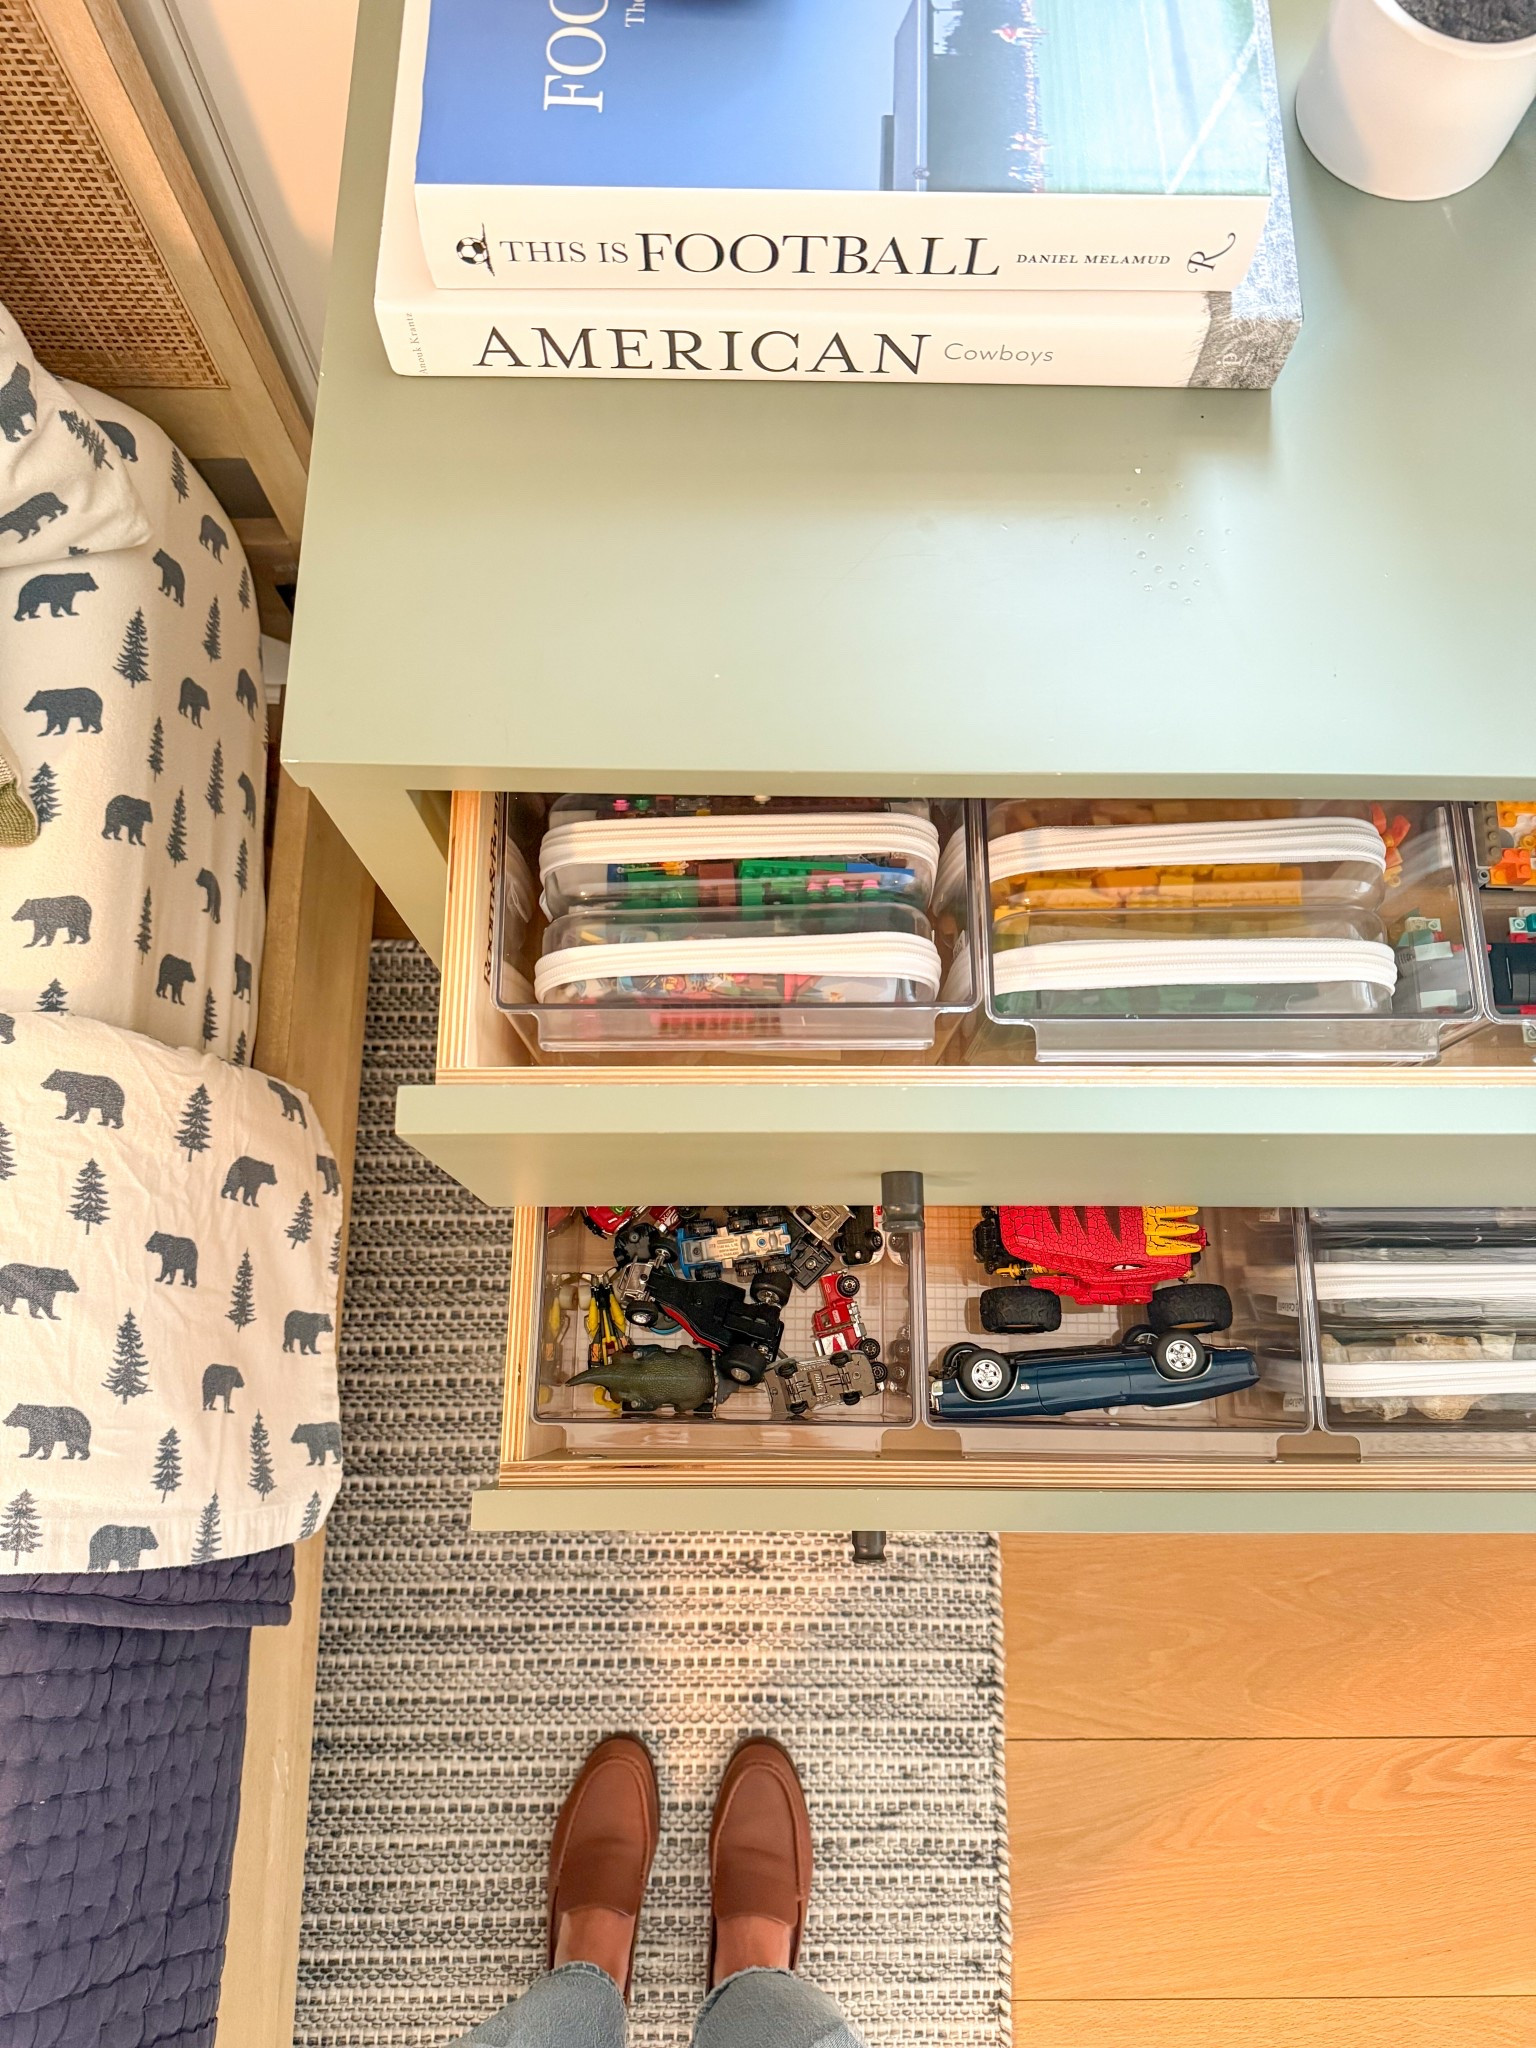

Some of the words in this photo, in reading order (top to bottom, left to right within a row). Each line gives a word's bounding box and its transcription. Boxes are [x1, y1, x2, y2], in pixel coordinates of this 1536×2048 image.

[625, 0, 646, 28] Th
[500, 240, 587, 264] THIS
[596, 241, 629, 264] IS
[635, 232, 1000, 276] FOOTBALL
[1016, 254, 1079, 265] DANIEL
[1083, 254, 1171, 266] MELAMUD
[1186, 232, 1236, 274] R
[406, 312, 420, 344] Krantz
[412, 347, 429, 375] Anouk
[472, 325, 932, 375] AMERICAN
[944, 342, 1054, 366] Cowboys
